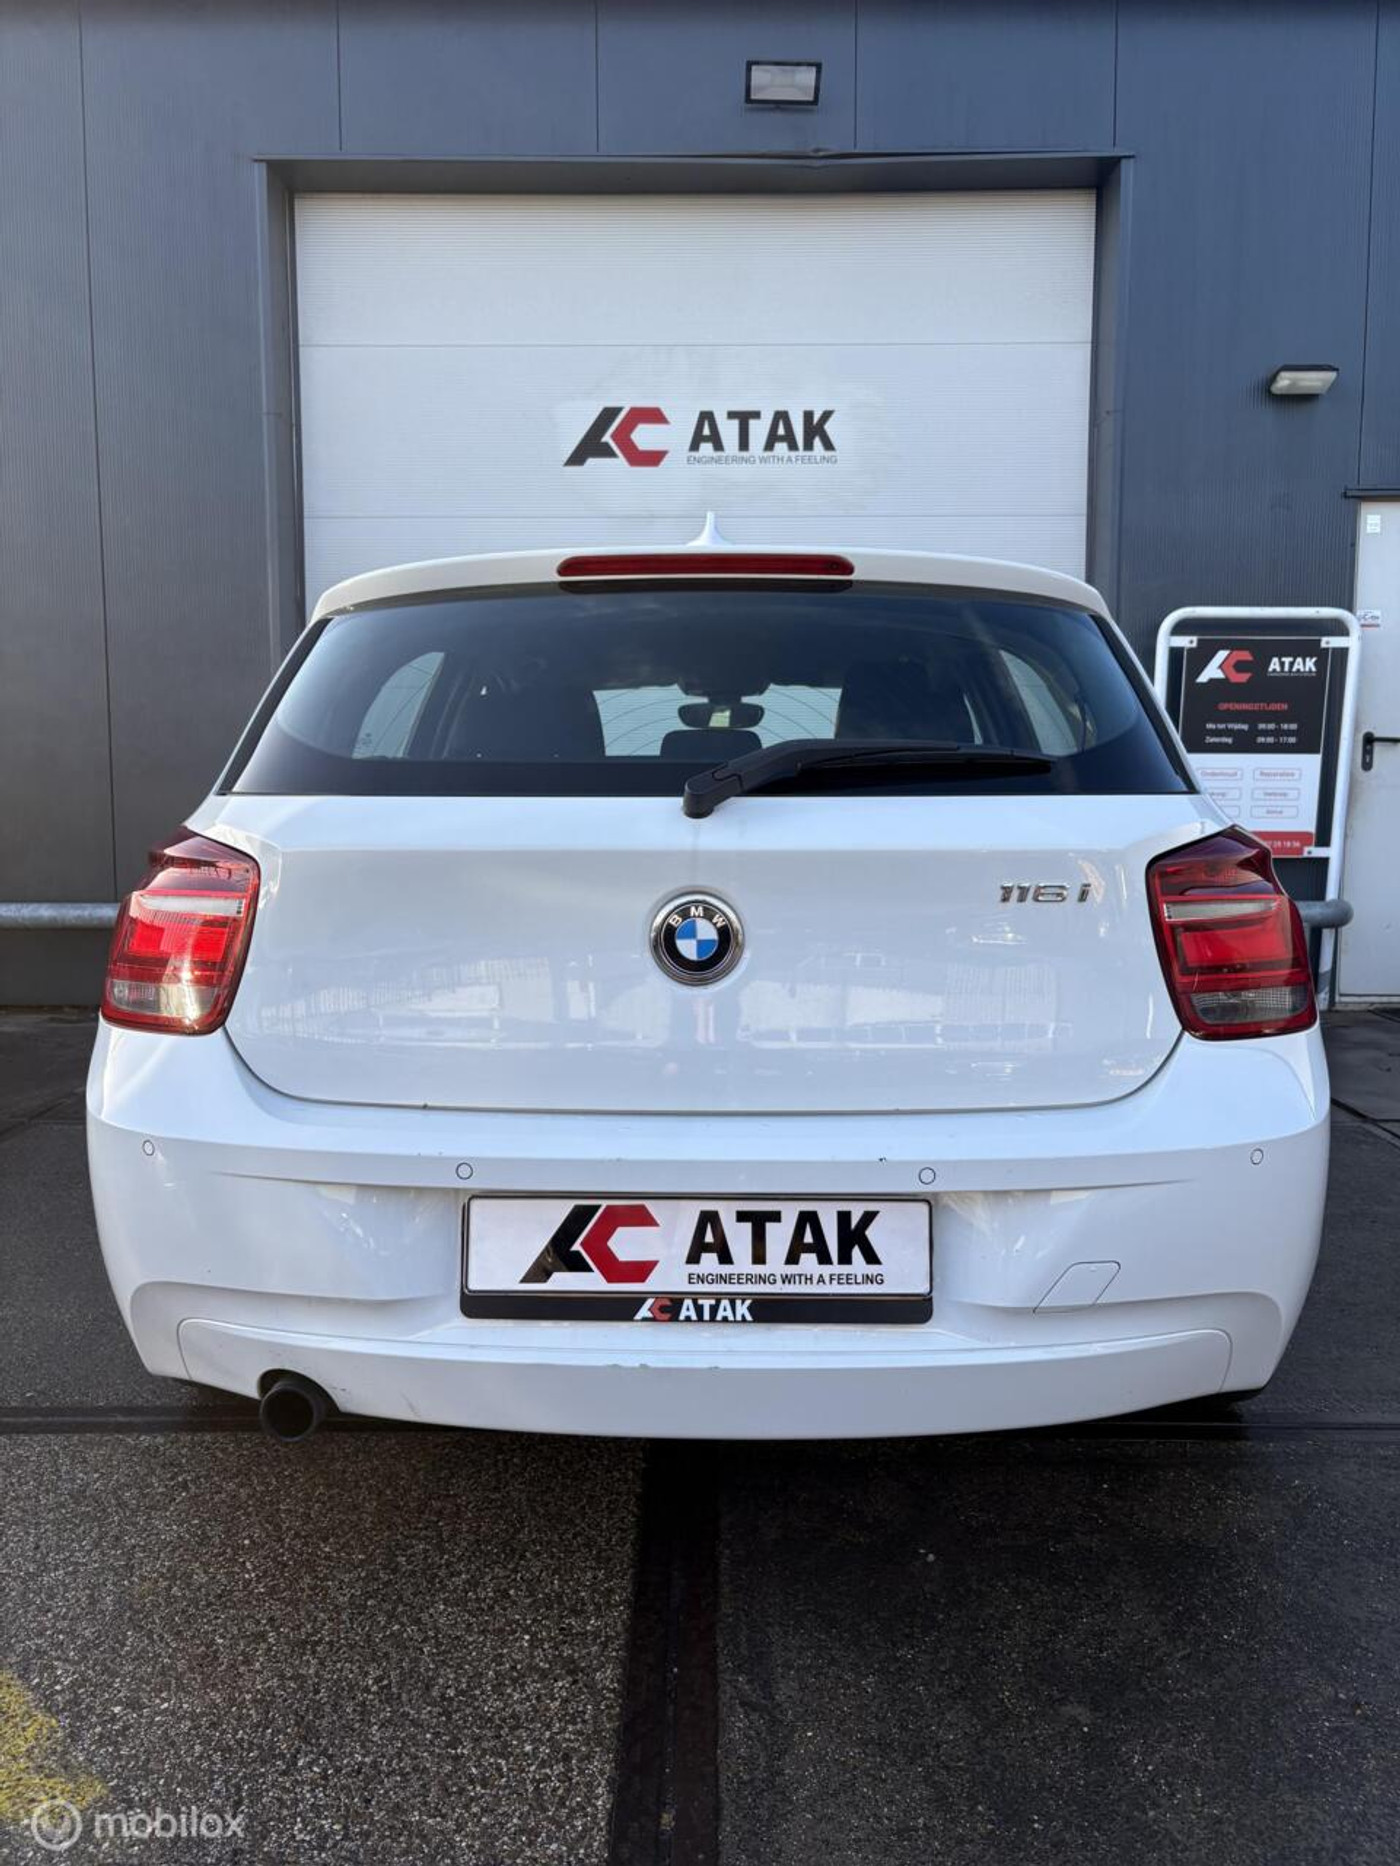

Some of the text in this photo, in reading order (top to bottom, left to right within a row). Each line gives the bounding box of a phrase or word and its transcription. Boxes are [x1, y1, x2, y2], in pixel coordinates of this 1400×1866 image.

[688, 410, 836, 452] ATAK
[686, 455, 838, 465] ENGINEERING WITH A FEELING
[1267, 657, 1318, 672] ATAK
[668, 905, 727, 928] BMW
[685, 1210, 882, 1265] ATAK
[688, 1273, 885, 1285] ENGINEERING WITH A FEELING
[678, 1299, 754, 1321] ATAK
